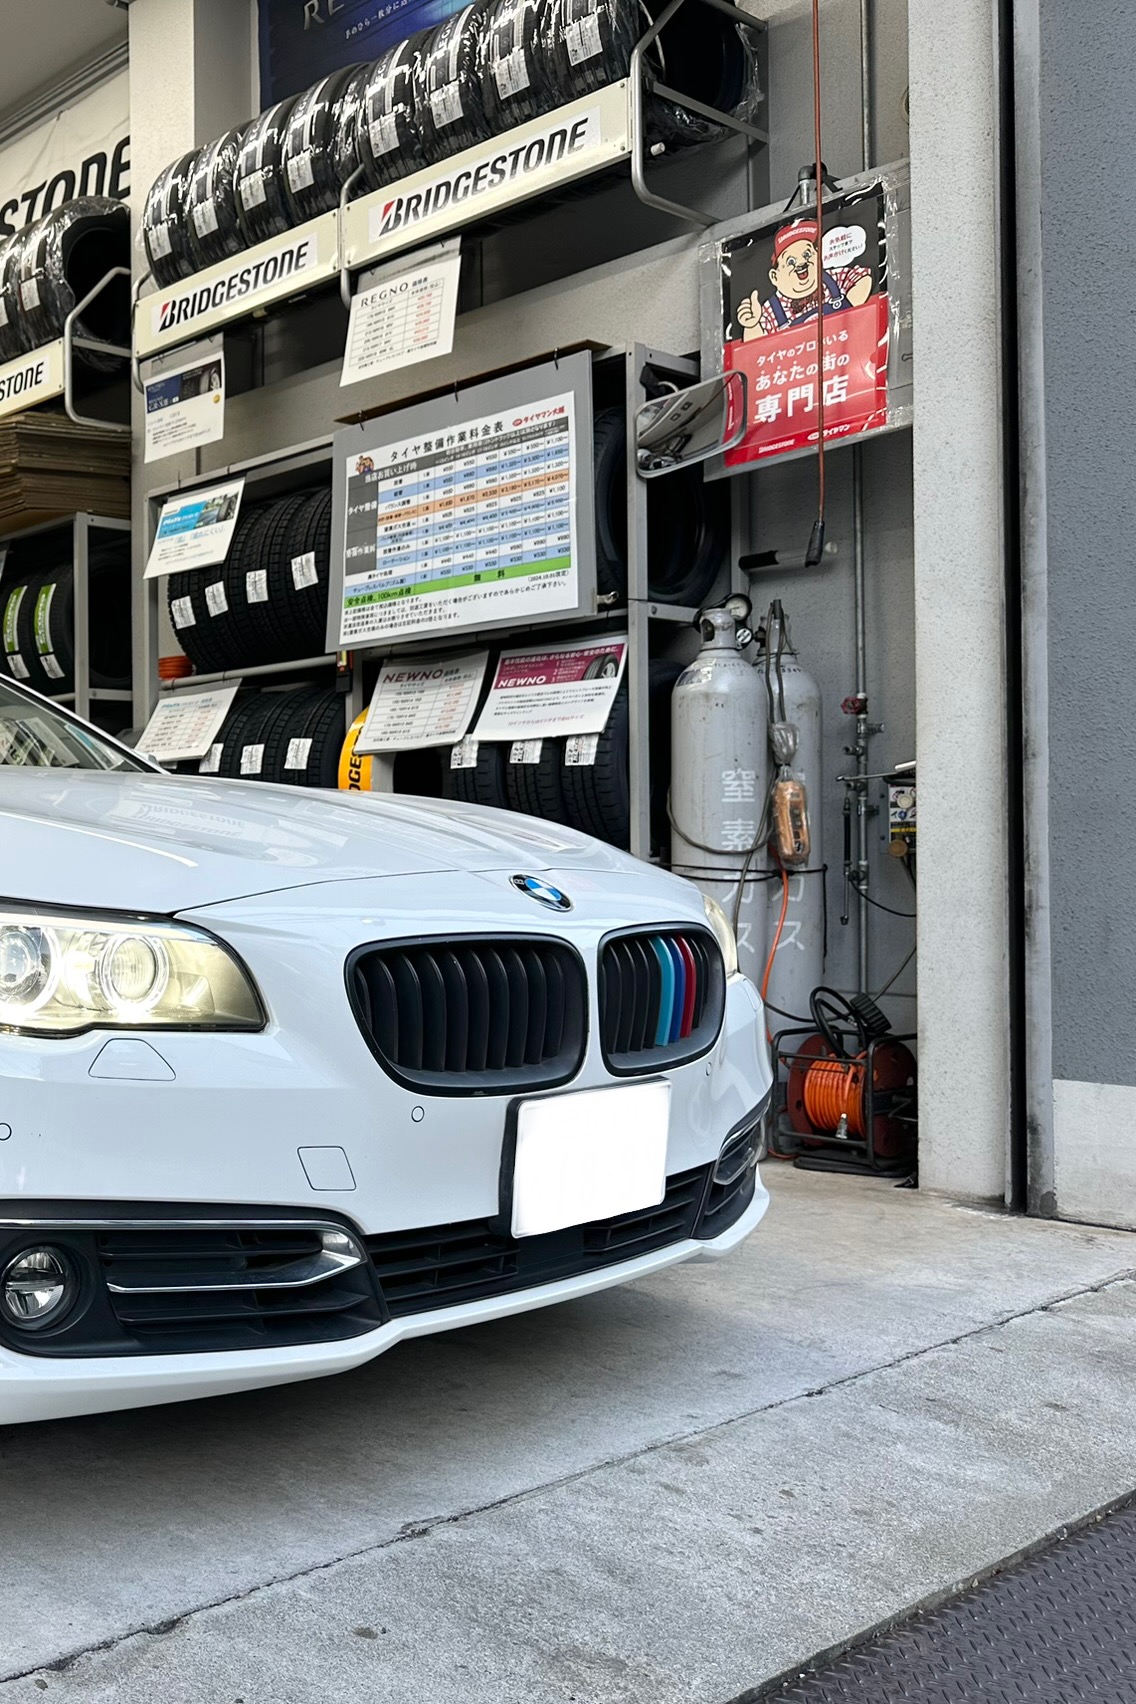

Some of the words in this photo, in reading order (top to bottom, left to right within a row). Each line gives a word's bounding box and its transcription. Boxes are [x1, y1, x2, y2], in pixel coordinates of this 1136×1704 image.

[379, 117, 589, 237] BRIDGESTONE
[159, 242, 309, 332] BRIDGESTONE
[361, 282, 409, 307] REGNO
[757, 330, 848, 366] タイヤのプロいる
[755, 352, 850, 391] あなたの街の
[754, 375, 849, 423] 専門店
[391, 421, 503, 462] タイヤ整備作業料金表
[383, 669, 443, 683] NEWNO
[498, 675, 546, 688] NEWNO
